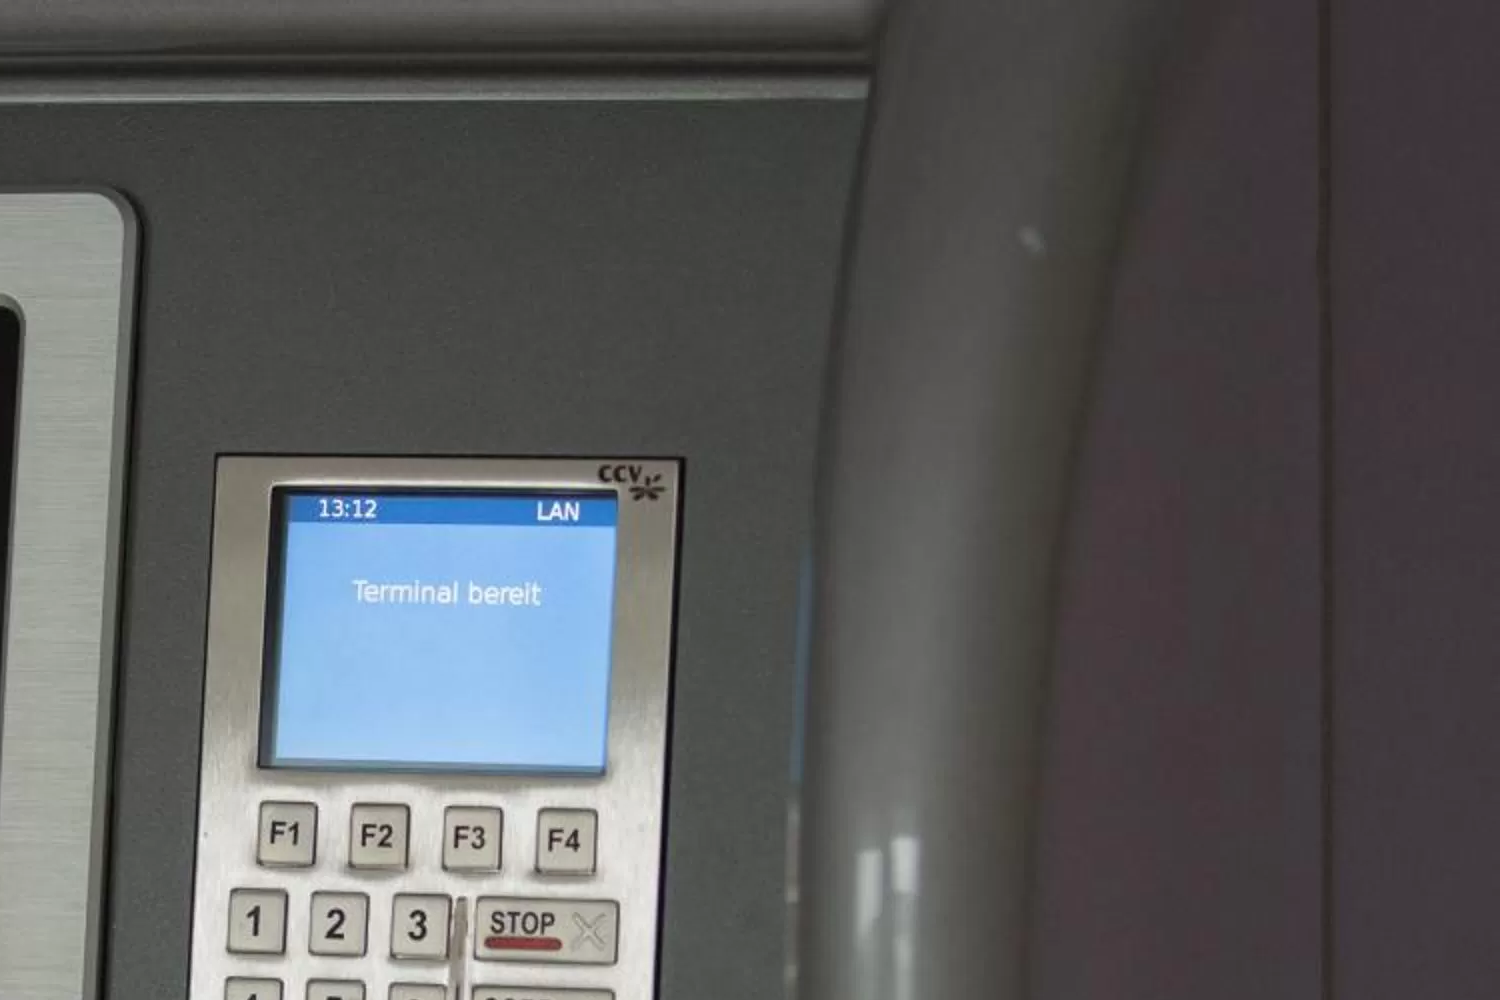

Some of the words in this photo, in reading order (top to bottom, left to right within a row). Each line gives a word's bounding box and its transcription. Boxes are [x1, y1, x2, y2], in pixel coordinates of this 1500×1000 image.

[598, 464, 642, 484] CCV
[318, 499, 377, 519] 13:12
[536, 501, 580, 521] LAN
[352, 579, 459, 604] Terminal
[468, 581, 542, 606] bereit
[269, 821, 301, 846] F1
[361, 824, 393, 848] F2
[453, 826, 486, 849] F3
[547, 829, 581, 852] F4
[245, 905, 261, 937] 1
[325, 909, 346, 940] 2
[407, 910, 428, 942] 3
[490, 912, 556, 936] STOP
